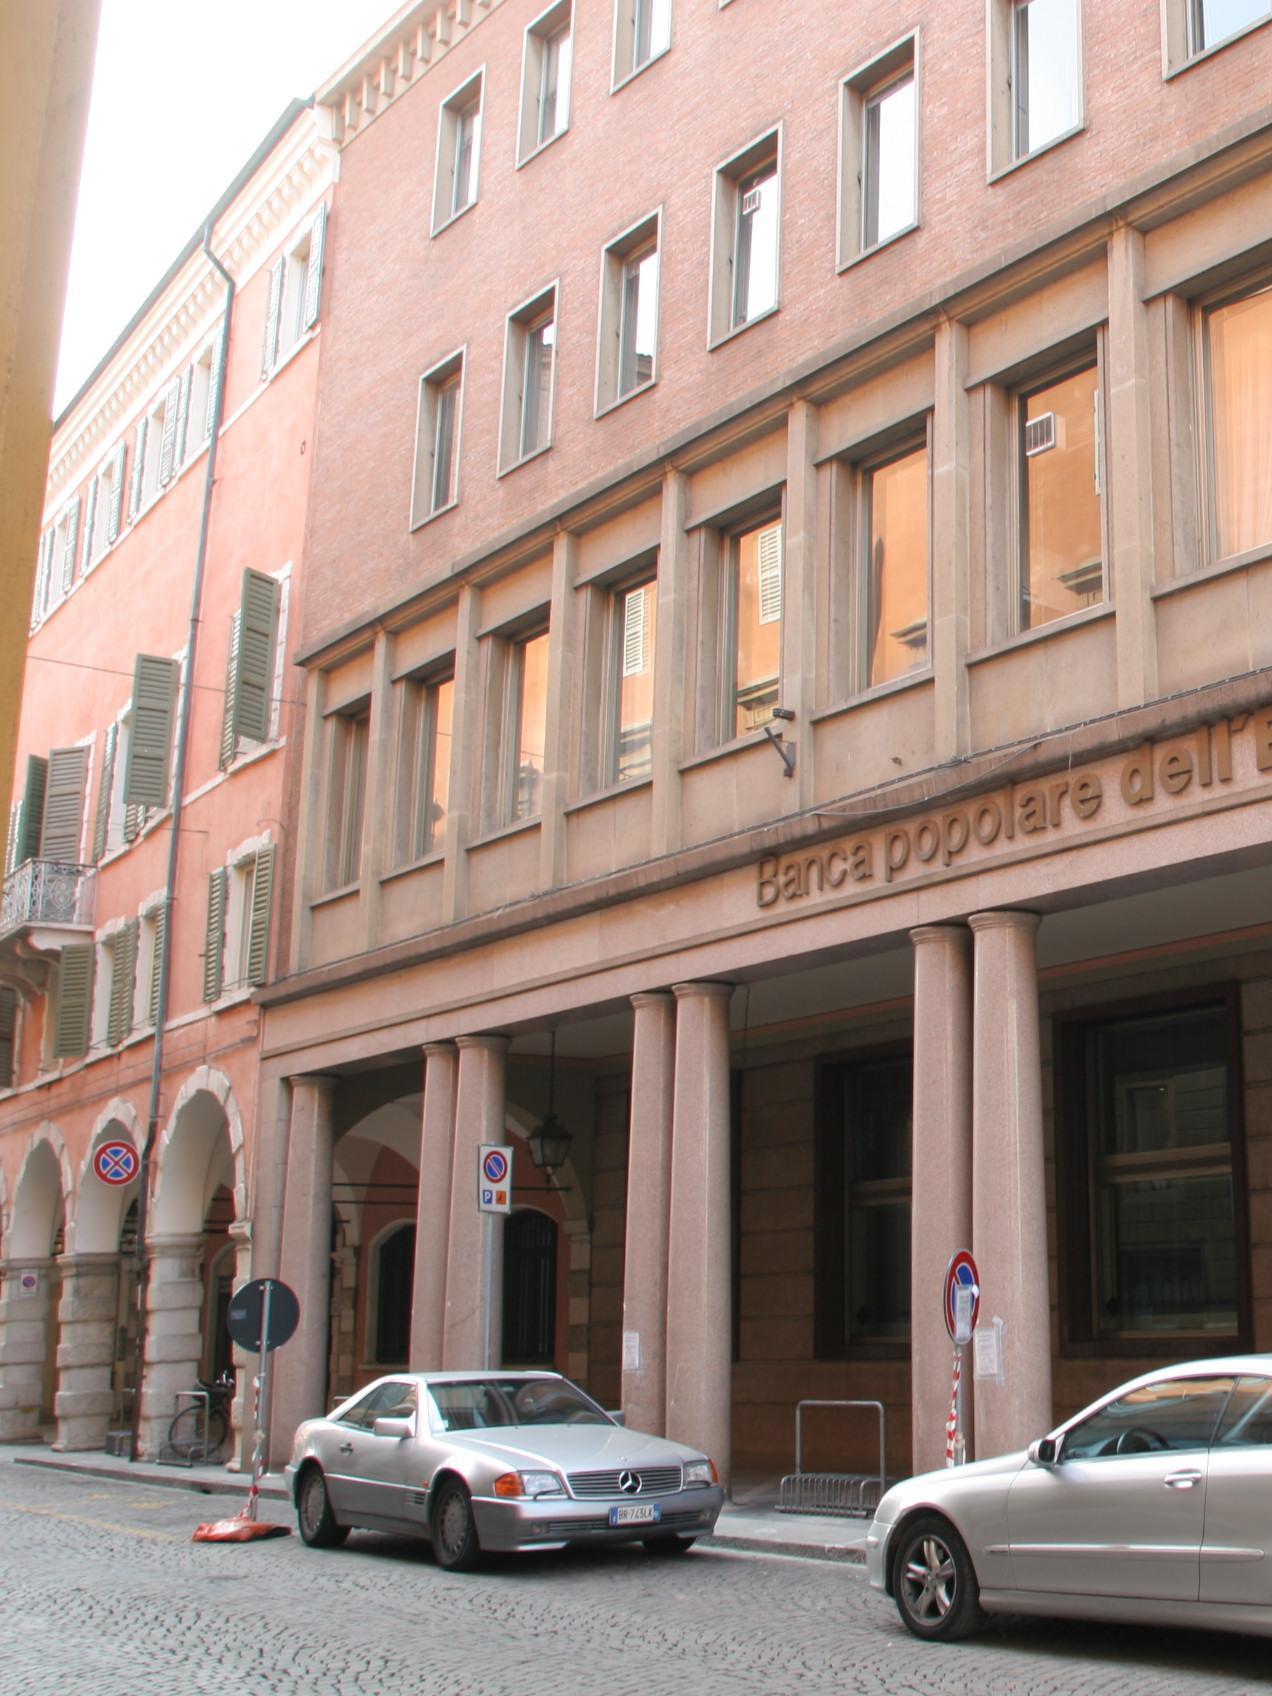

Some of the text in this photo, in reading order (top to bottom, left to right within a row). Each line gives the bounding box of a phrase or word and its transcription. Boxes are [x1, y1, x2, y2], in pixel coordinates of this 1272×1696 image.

[756, 838, 873, 908] Banca
[884, 772, 1103, 882] popolare
[484, 1191, 492, 1202] P
